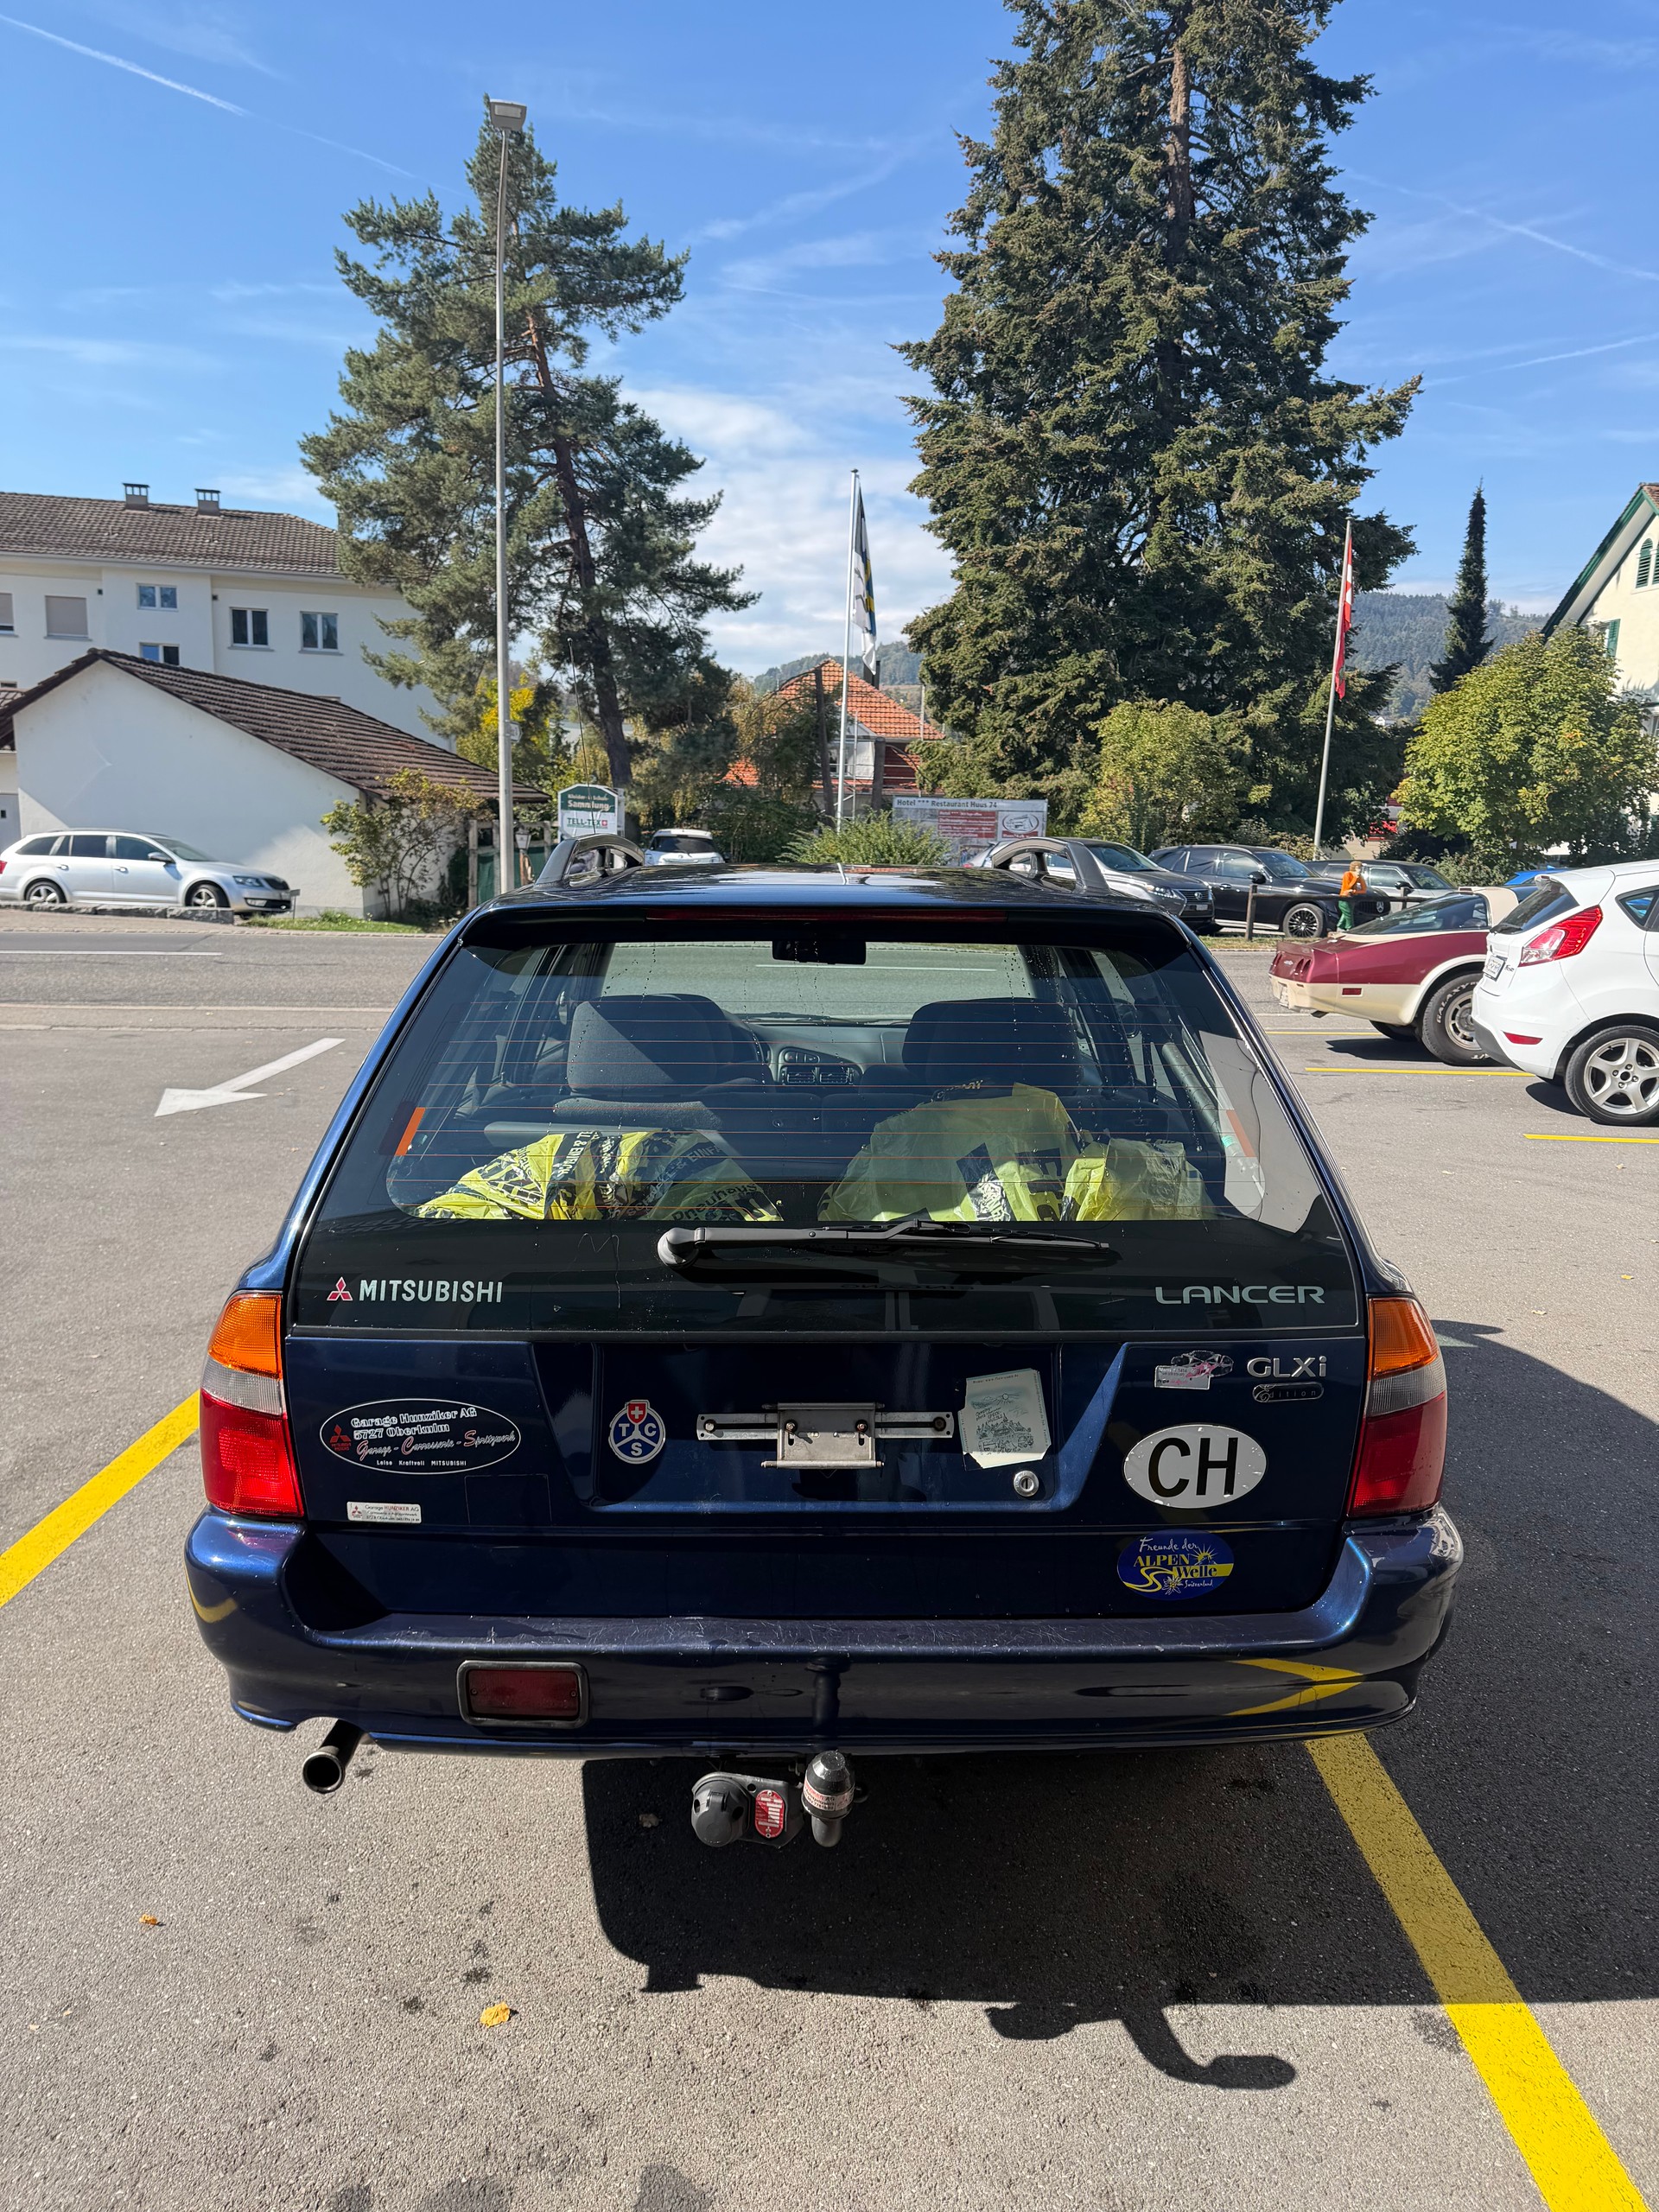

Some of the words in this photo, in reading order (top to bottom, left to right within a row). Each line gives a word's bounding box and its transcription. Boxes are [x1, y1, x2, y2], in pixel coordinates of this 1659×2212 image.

[568, 800, 609, 811] Sammlung
[931, 800, 969, 809] Restaurant
[1436, 982, 1469, 1023] GALAXY
[359, 1279, 503, 1303] MITSUBISHI
[1154, 1286, 1325, 1305] LANCER
[1247, 1356, 1327, 1378] GLXi
[351, 1415, 398, 1428] Garage
[399, 1409, 459, 1424] Hunziker
[460, 1407, 478, 1418] AG
[353, 1427, 385, 1440] 5727
[386, 1422, 450, 1437] Oberkulm
[356, 1440, 392, 1462] Garage
[1147, 1436, 1239, 1498] CH
[1139, 1536, 1179, 1553] Freunde
[1182, 1538, 1199, 1552] der
[1134, 1554, 1191, 1567] ALPEN
[1176, 1564, 1217, 1579] Welle
